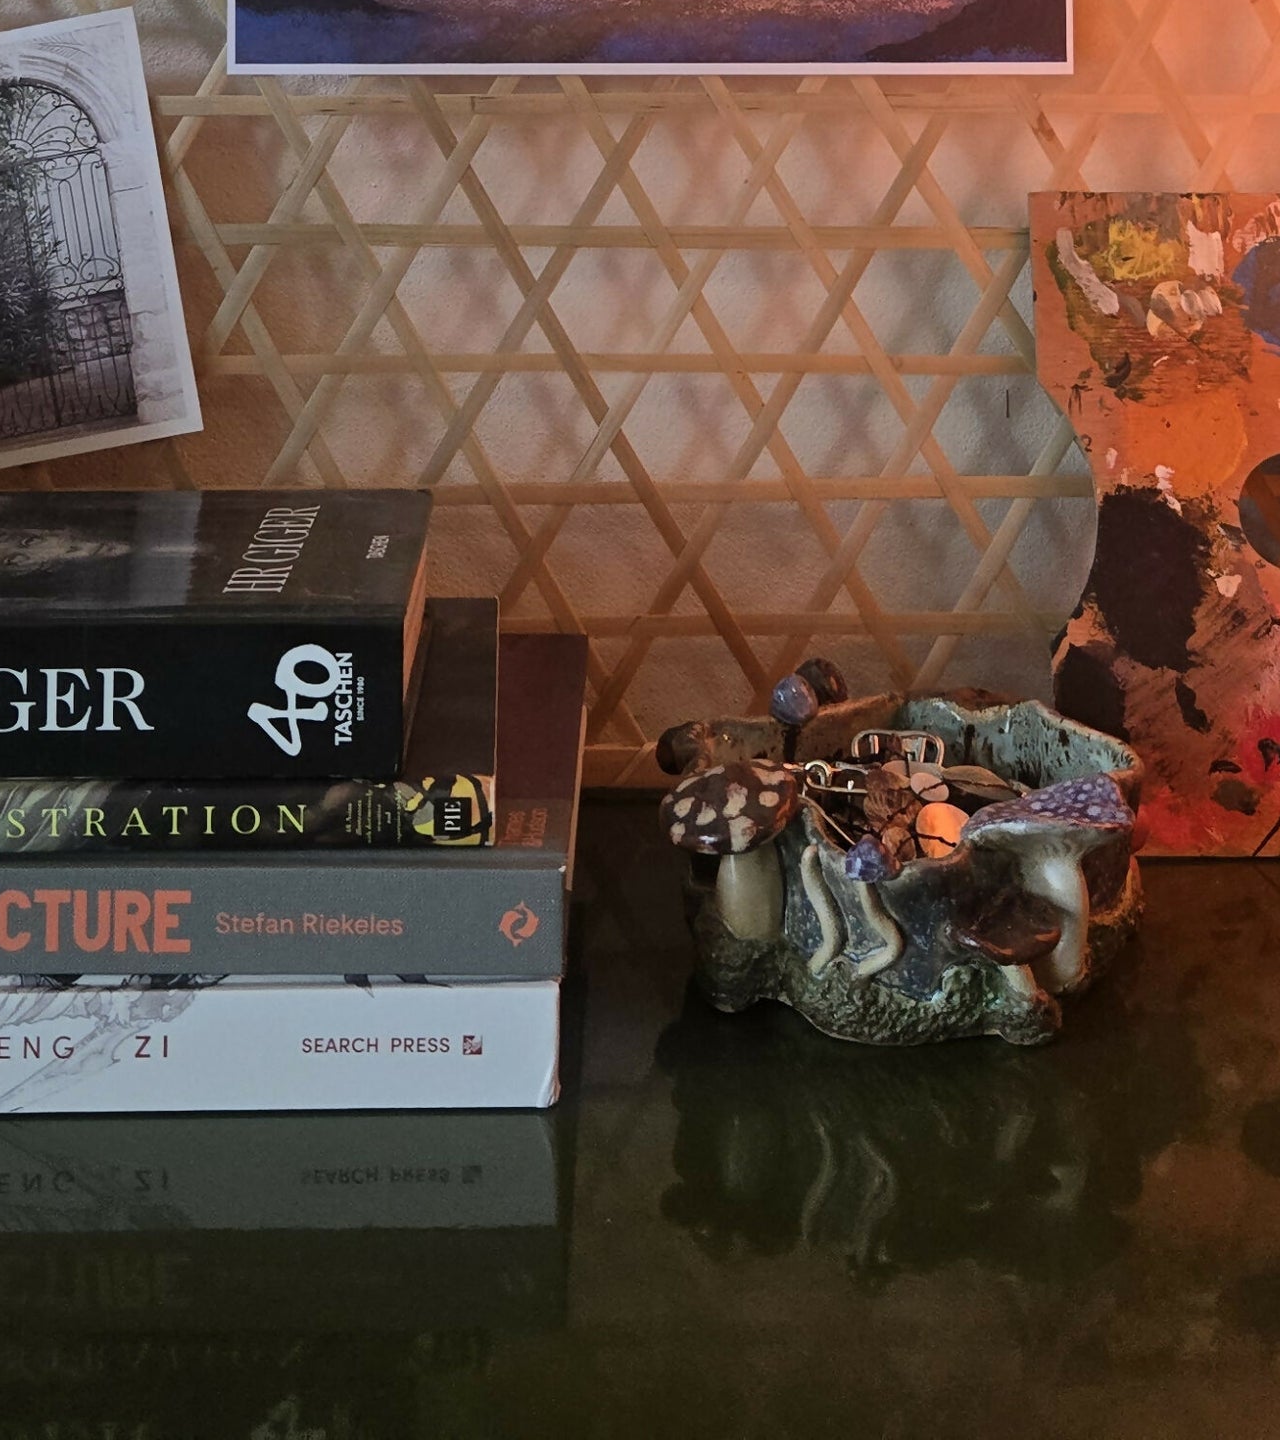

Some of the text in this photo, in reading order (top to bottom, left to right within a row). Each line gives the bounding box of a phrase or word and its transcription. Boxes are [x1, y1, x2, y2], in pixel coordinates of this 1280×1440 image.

[222, 505, 321, 593] HR GIGER
[247, 643, 340, 756] 40
[334, 653, 352, 746] TASCHEN
[444, 801, 461, 832] PIE
[215, 912, 404, 936] Stefan Riekeles
[135, 1035, 168, 1058] ZI
[301, 1037, 451, 1054] SEARCH PRESS
